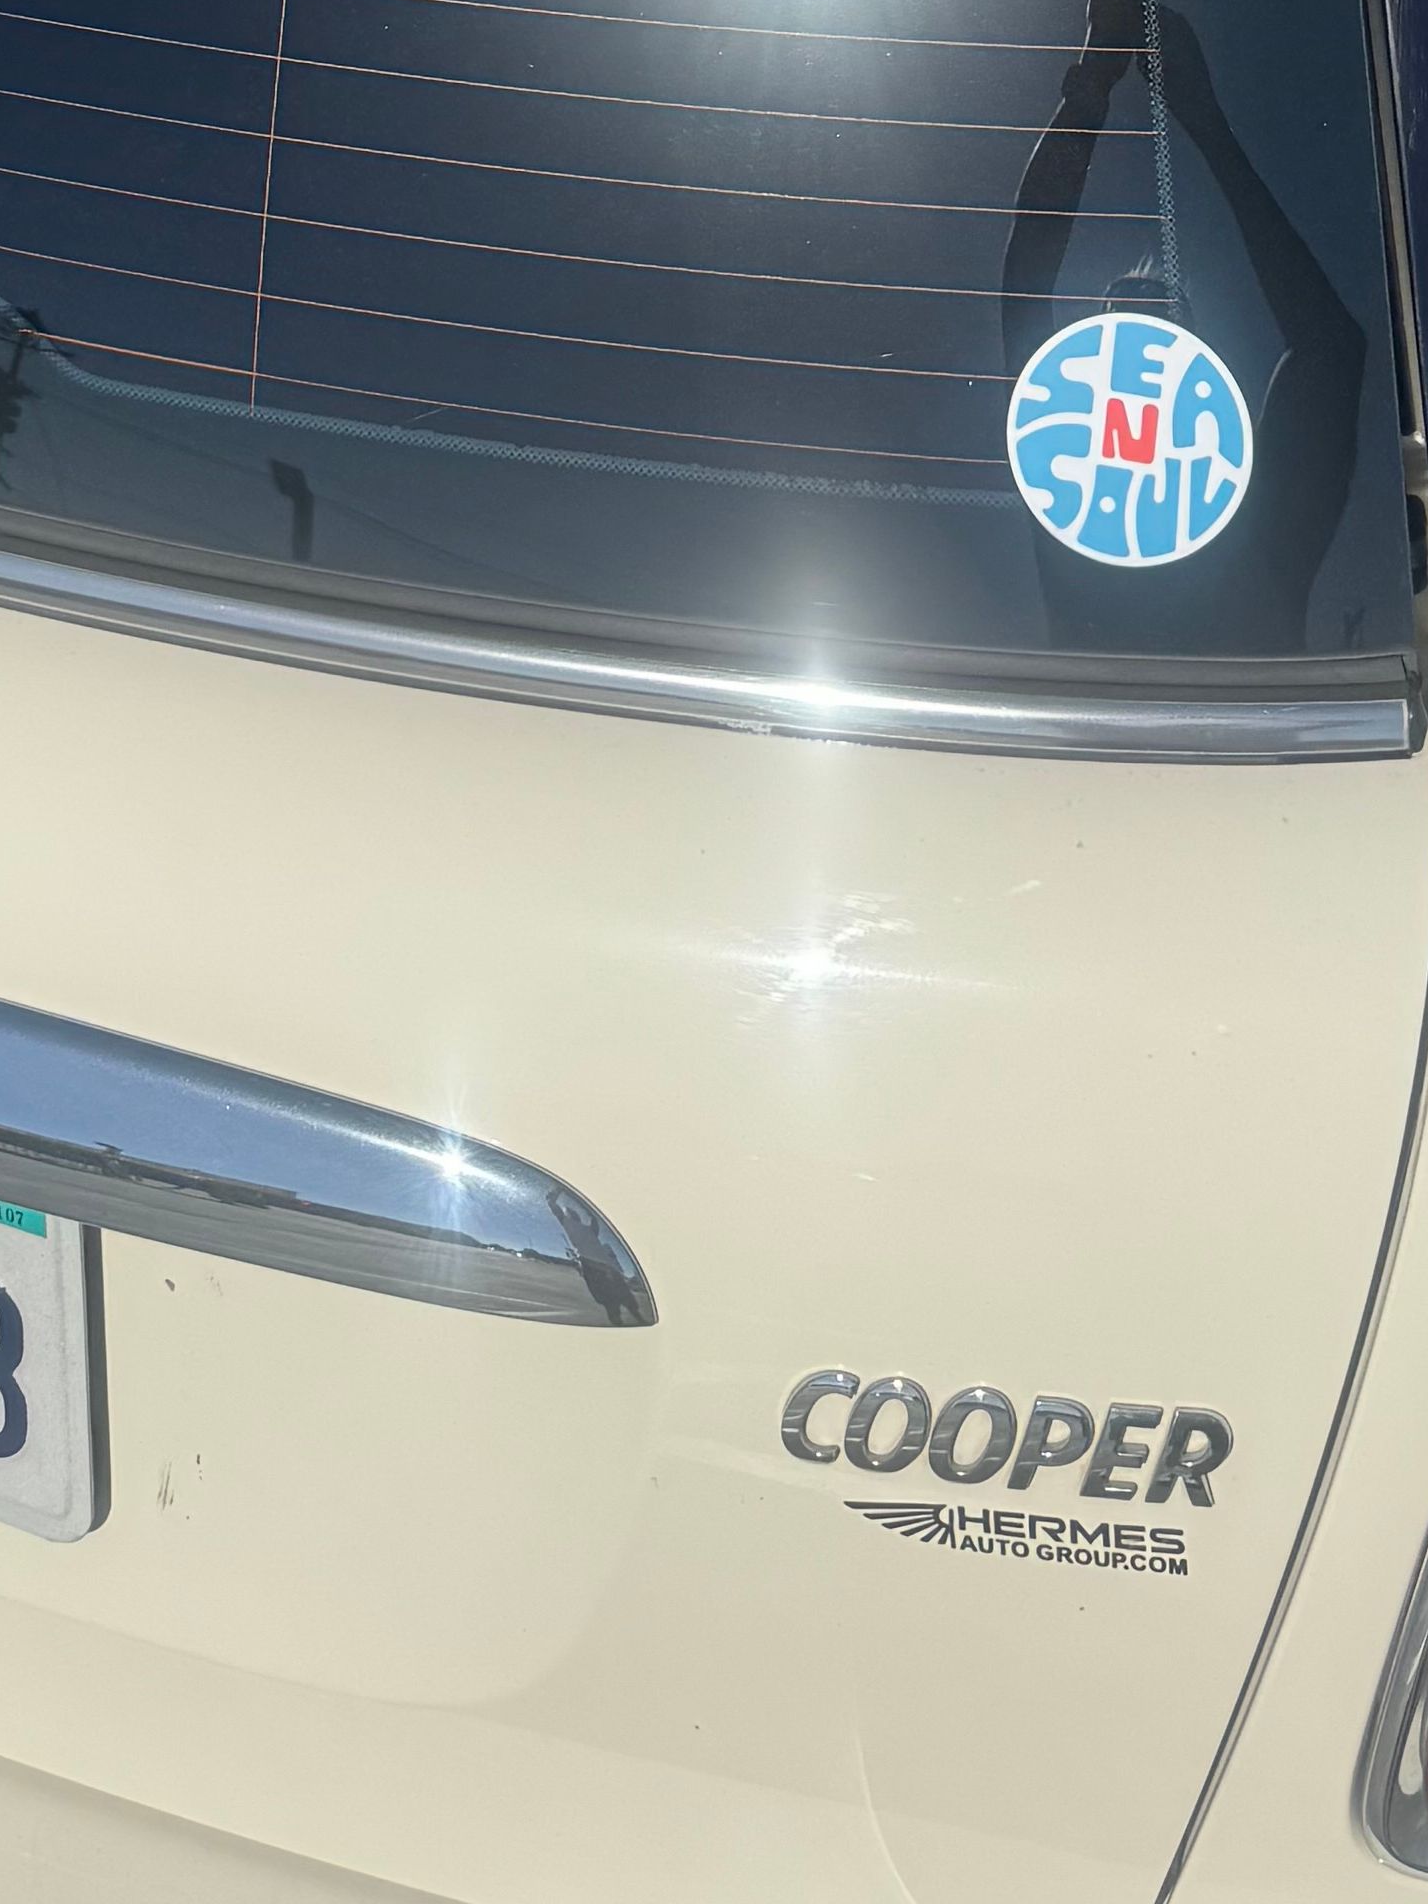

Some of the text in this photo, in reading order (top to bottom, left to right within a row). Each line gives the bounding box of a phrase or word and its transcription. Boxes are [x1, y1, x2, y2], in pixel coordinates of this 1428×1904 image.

[1015, 321, 1245, 469] SEA
[1102, 398, 1159, 464] N
[1015, 423, 1238, 558] SOUL
[780, 1368, 1234, 1508] COOPER
[957, 1506, 1186, 1554] HERMES
[960, 1534, 1189, 1576] AUTO GROUP.COM
